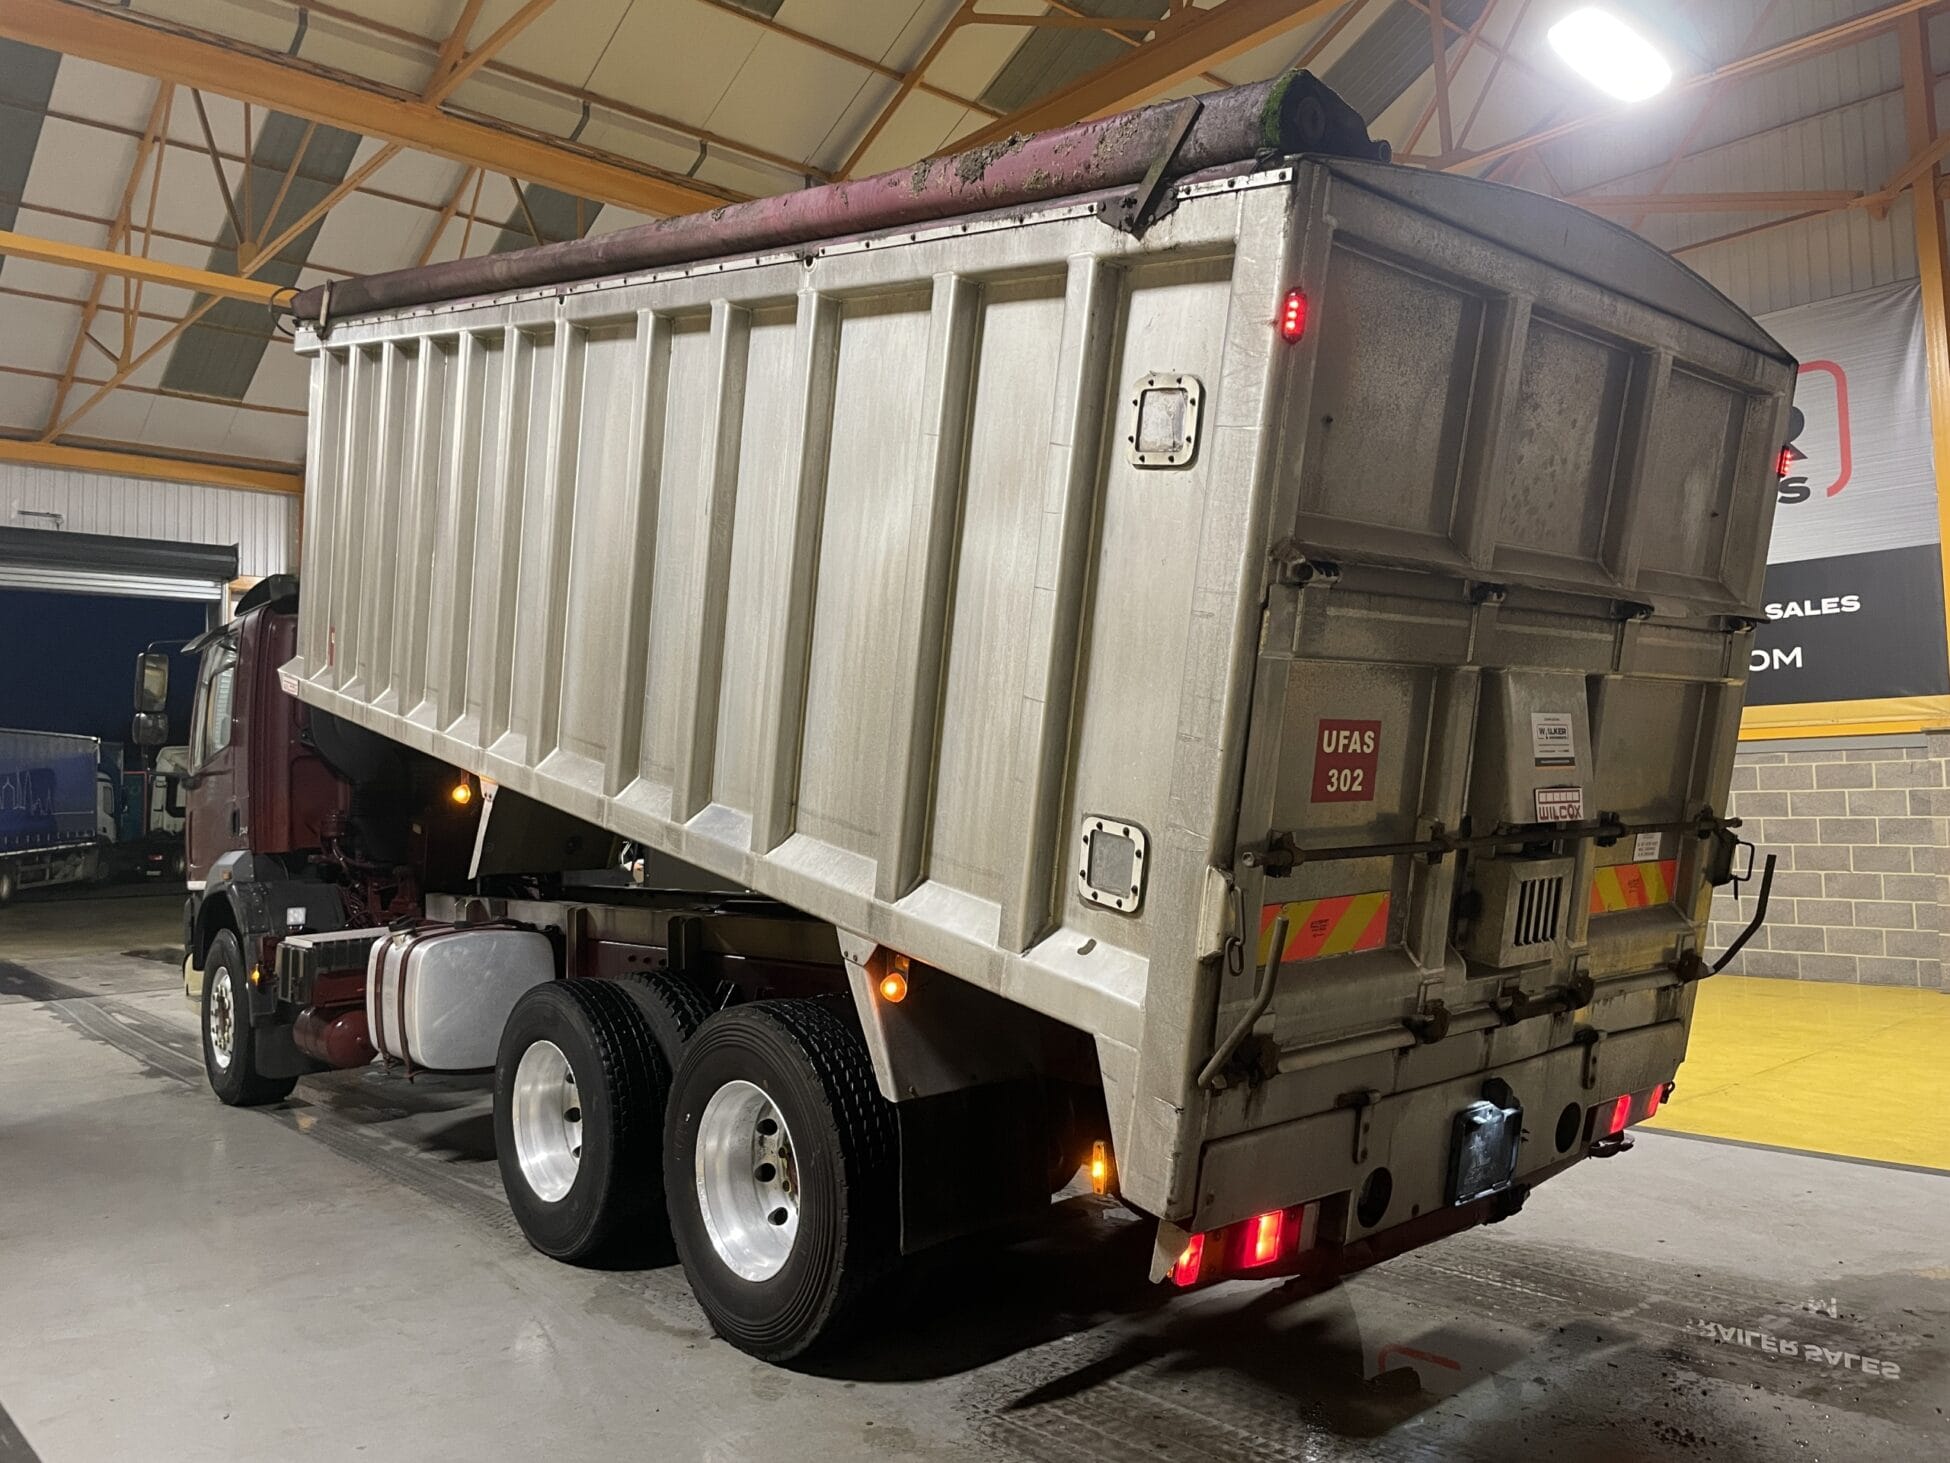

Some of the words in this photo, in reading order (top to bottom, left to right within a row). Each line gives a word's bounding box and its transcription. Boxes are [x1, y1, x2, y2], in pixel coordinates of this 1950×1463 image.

[1764, 595, 1861, 620] SALES
[1323, 730, 1375, 754] UFAS
[1326, 768, 1364, 792] 302
[1539, 804, 1582, 820] WILCOX
